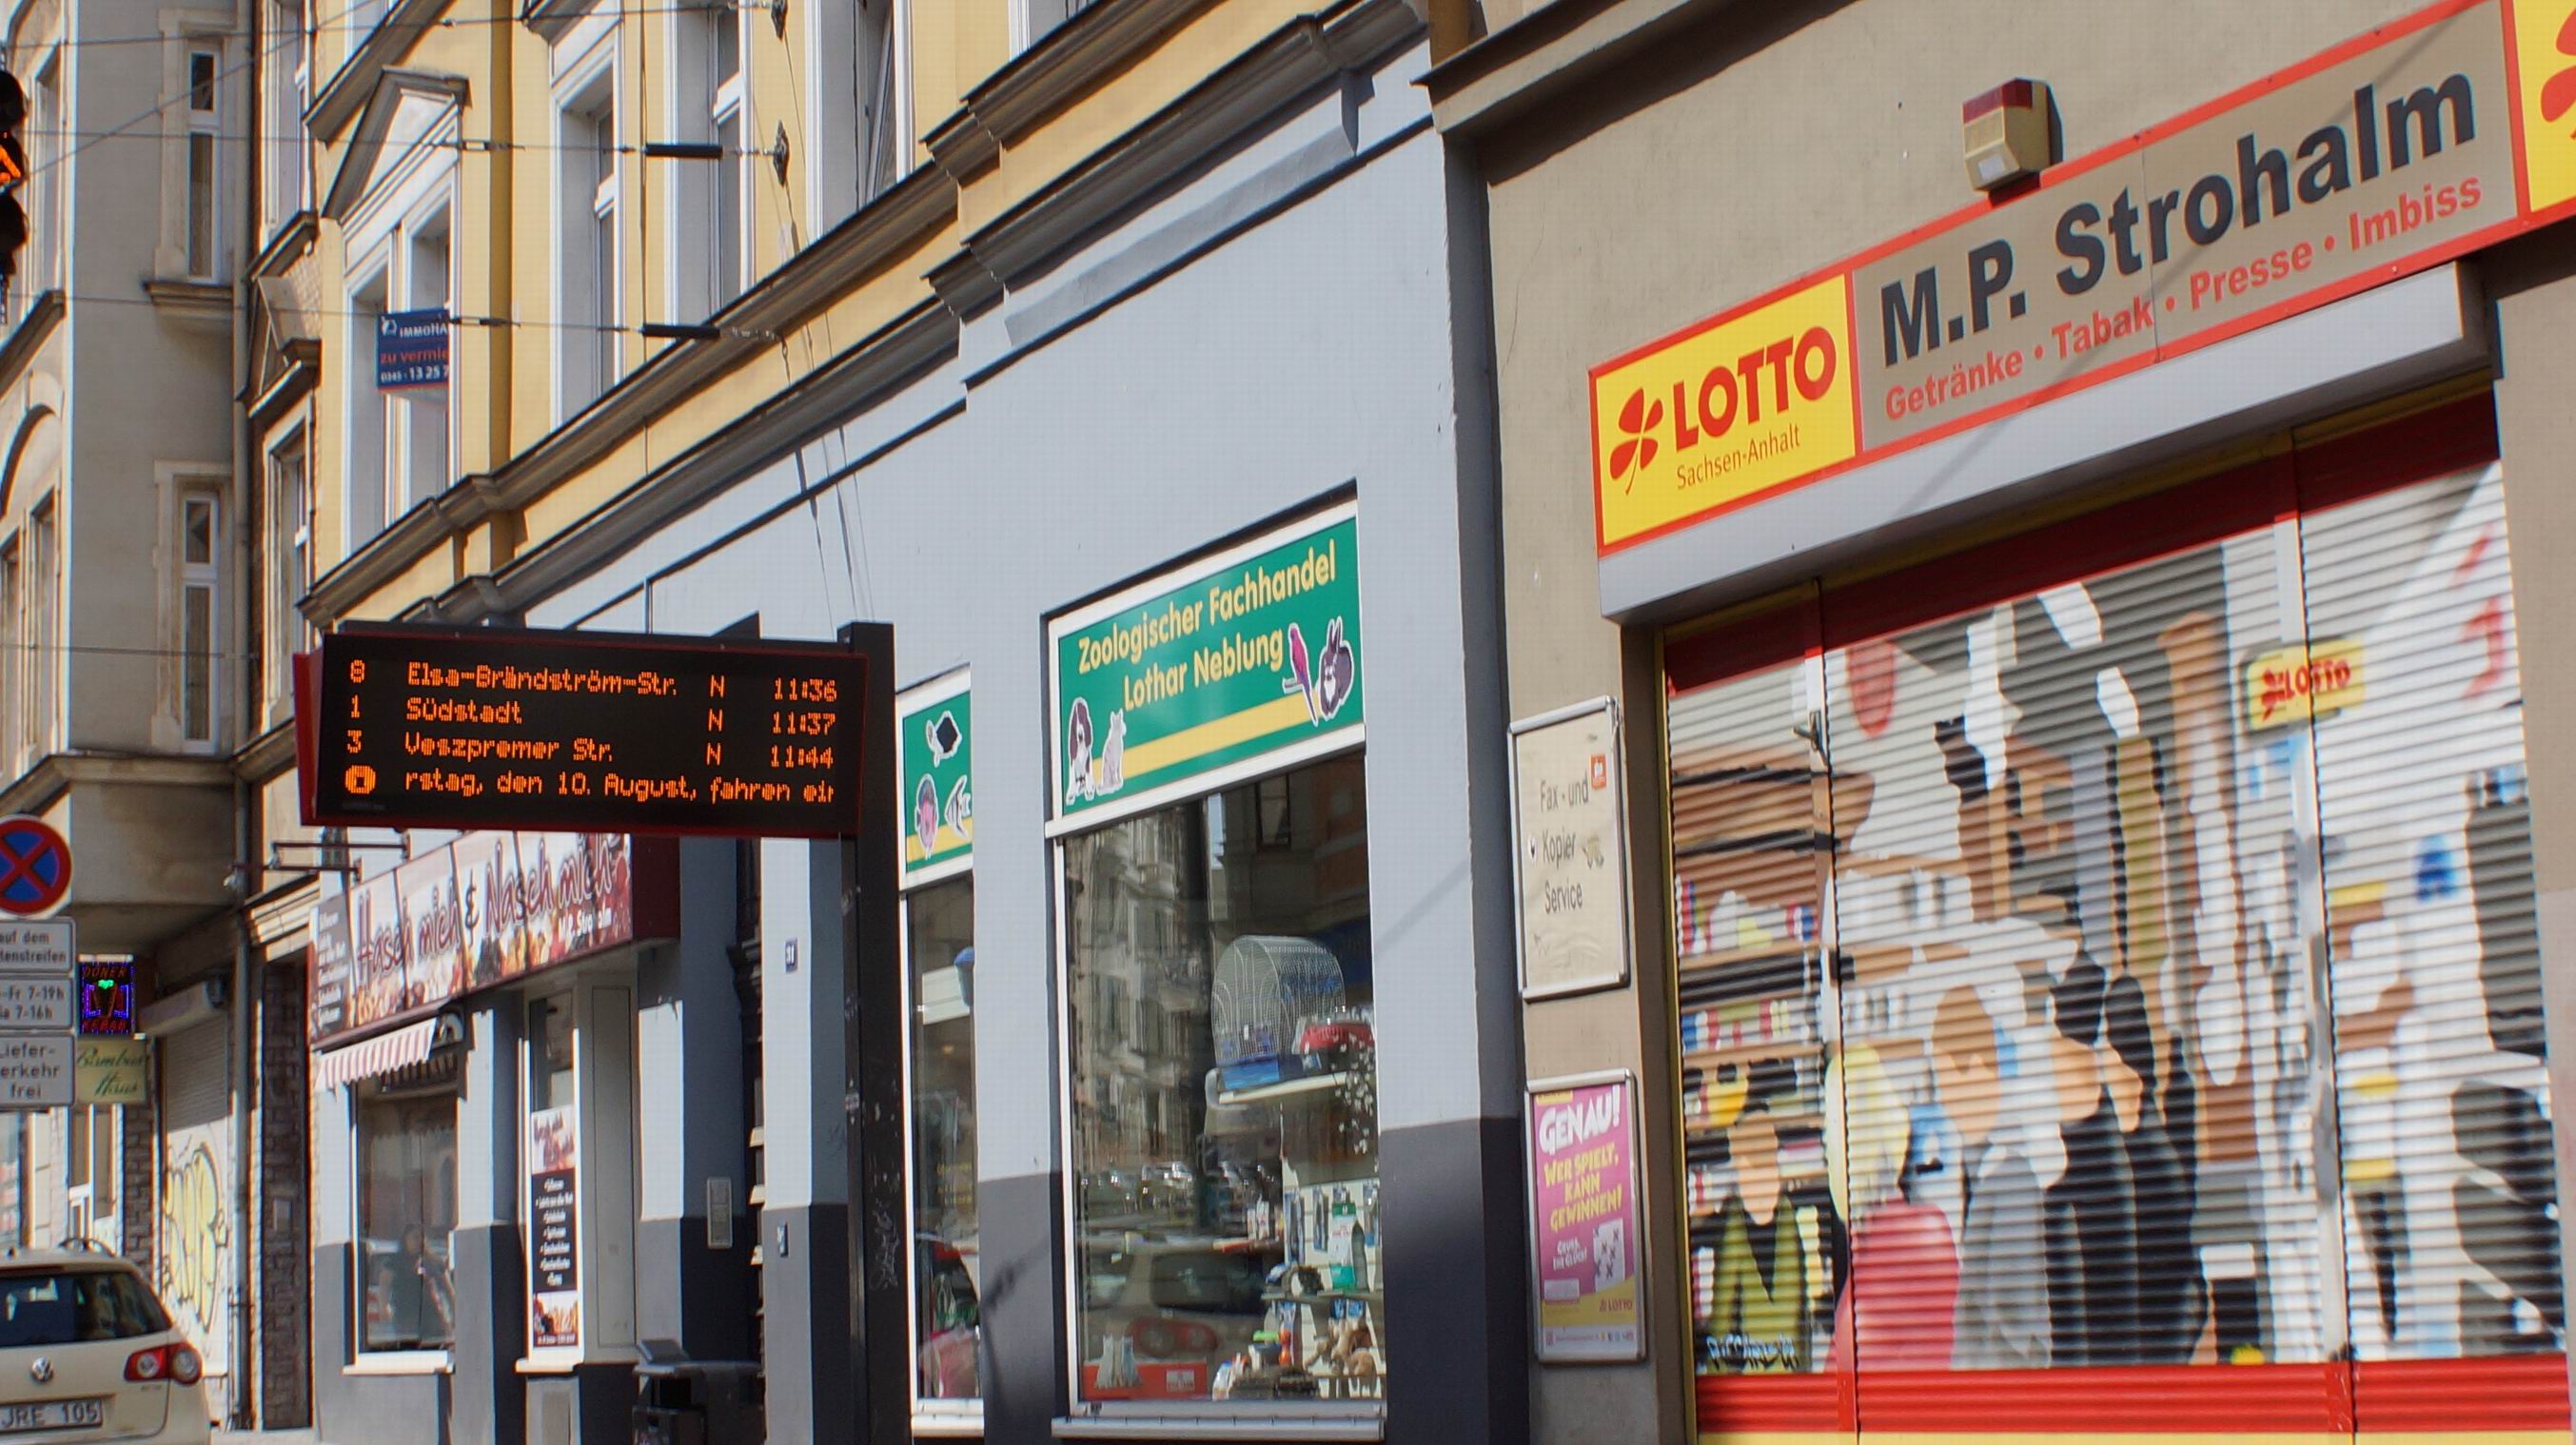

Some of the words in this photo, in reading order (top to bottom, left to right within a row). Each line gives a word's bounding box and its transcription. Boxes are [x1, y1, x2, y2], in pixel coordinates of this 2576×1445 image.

[1880, 238, 2027, 368] M.P.
[2055, 73, 2476, 296] Strohalm
[1885, 348, 2024, 420] Getränke
[2051, 294, 2154, 361] Tabak
[2189, 241, 2313, 312] Presse
[2349, 176, 2482, 252] Imbiss
[1672, 325, 1838, 453] LOTTO
[1677, 422, 1801, 491] Sachsen-Anhalt
[1079, 599, 1203, 674] Zoologischer
[1209, 537, 1336, 626] Fachhandel
[407, 661, 677, 696] Elsa-Brändström-Str.
[710, 674, 725, 698] N
[775, 676, 837, 702] 11:36
[1124, 661, 1188, 712] Lothar
[1193, 628, 1284, 688] Neblung
[2284, 659, 2351, 700] LOTTO
[350, 693, 360, 718] 1
[406, 696, 522, 725] Südstadt
[708, 709, 723, 732] N
[773, 711, 836, 735] 11:37
[347, 730, 362, 753] 3
[404, 731, 560, 762] Veszpremer
[573, 737, 613, 762] Str.
[706, 742, 721, 766] N
[771, 745, 834, 769] 11:44
[405, 768, 483, 797] rstag,
[497, 770, 542, 794] den
[559, 771, 591, 795] 10.
[604, 772, 697, 802] August,
[710, 776, 791, 805] fahren
[1540, 780, 1559, 812] Fax
[1568, 774, 1589, 807] und
[1542, 826, 1577, 869] Kopier
[357, 890, 414, 986] Hasch
[419, 879, 462, 958] mich
[485, 838, 554, 935] Nasch
[1544, 878, 1583, 915] Service
[23, 928, 49, 945] dem
[11, 1083, 42, 1099] frei
[1539, 1084, 1621, 1156] GENAU!
[1544, 1158, 1572, 1188] WER
[1564, 1171, 1601, 1204] KANN
[1549, 1182, 1622, 1234] GEWINNEN!
